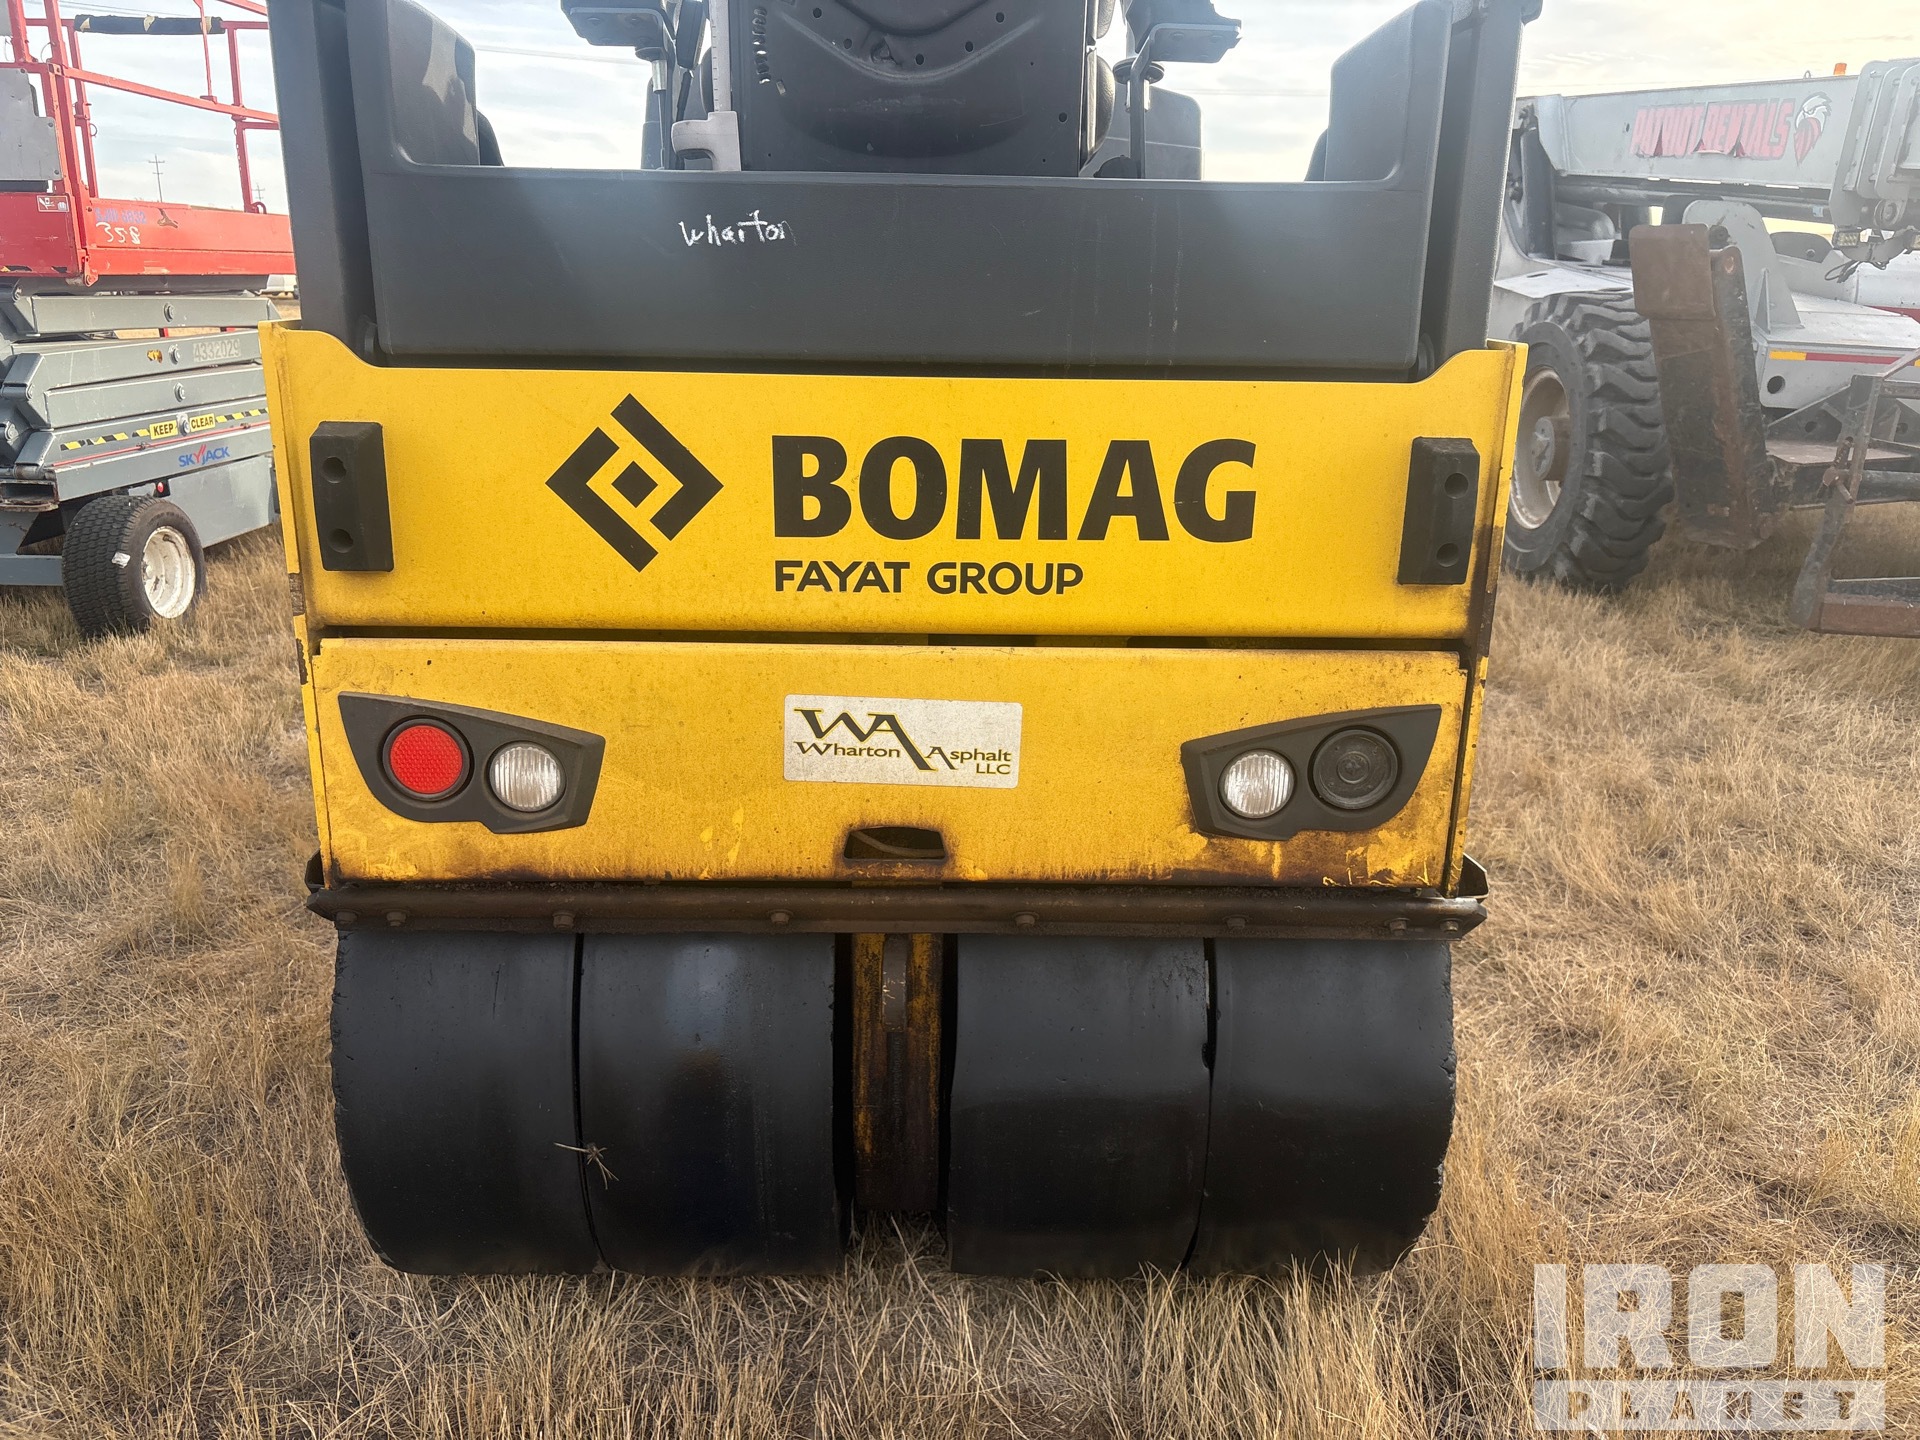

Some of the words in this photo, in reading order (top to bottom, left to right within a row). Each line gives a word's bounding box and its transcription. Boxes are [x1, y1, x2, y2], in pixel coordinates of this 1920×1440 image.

[1699, 99, 1795, 159] RENTALS
[95, 221, 141, 245] 358
[194, 339, 241, 361] 4332029
[153, 423, 174, 436] KEEP
[190, 416, 214, 429] CLEAR
[178, 444, 231, 468] SKYJACK
[772, 435, 1257, 542] BOMAG
[775, 560, 910, 593] FAYAT
[926, 561, 1085, 595] GROUP
[794, 708, 936, 771] WA
[794, 741, 900, 758] Wharton
[926, 746, 1012, 770] Asphalt
[976, 763, 1011, 775] LLC
